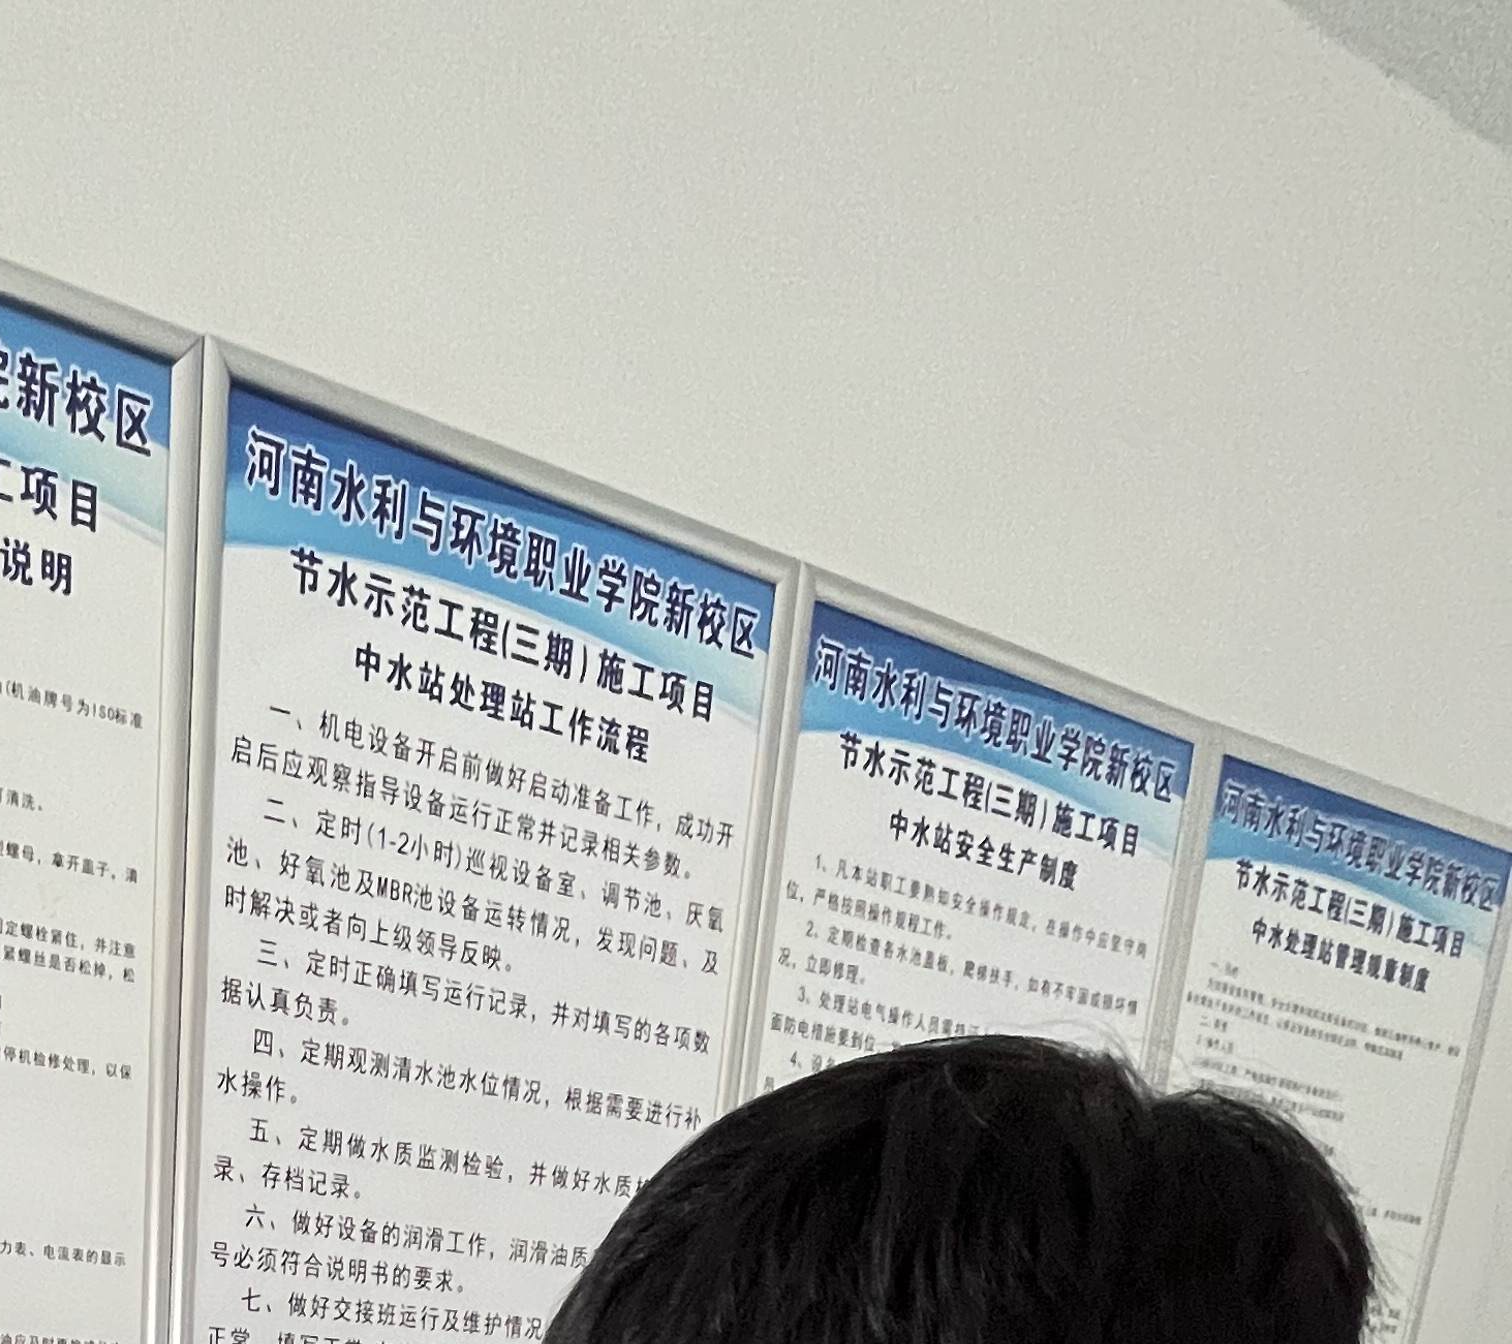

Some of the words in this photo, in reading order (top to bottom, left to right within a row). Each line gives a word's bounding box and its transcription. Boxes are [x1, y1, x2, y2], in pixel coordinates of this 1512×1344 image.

[245, 429, 759, 659] 河南水利与环境职业学院新校区
[289, 545, 714, 723] 节水示范工程(三期)施工项目
[354, 641, 649, 763] 中水站处理站工作流程
[813, 639, 1176, 803] 河南水利与环境职业学院新校区
[229, 733, 691, 880] 启后应观察指导设备运行正常并记录相关参数。
[267, 704, 735, 850] 一、机电设备开启前做好启动准备工作，成功开
[838, 730, 1139, 857] 节水示范工程(三期)施工项目
[225, 833, 719, 977] 池、好氧池及MBR池设备运转情况，发现问题、及
[889, 808, 1078, 891] 中水站安全生产制度
[223, 883, 512, 973] 时解决或者向上级领导反映。
[1235, 857, 1465, 958] 节水示范工程(三期)施工项目
[1251, 916, 1430, 993] 中水处理站管理规章制度
[219, 973, 349, 1027] 据认真负责。
[255, 937, 711, 1056] 三、定时正确填写运行记录，并对填写的各项数
[215, 1065, 298, 1105] 水操作。
[251, 1026, 702, 1131] 四、定期观测清水池水位情况，根据需要进行补
[212, 1153, 361, 1200] 录、存档记录。
[208, 1239, 464, 1294] 号必须符合说明书的要求。
